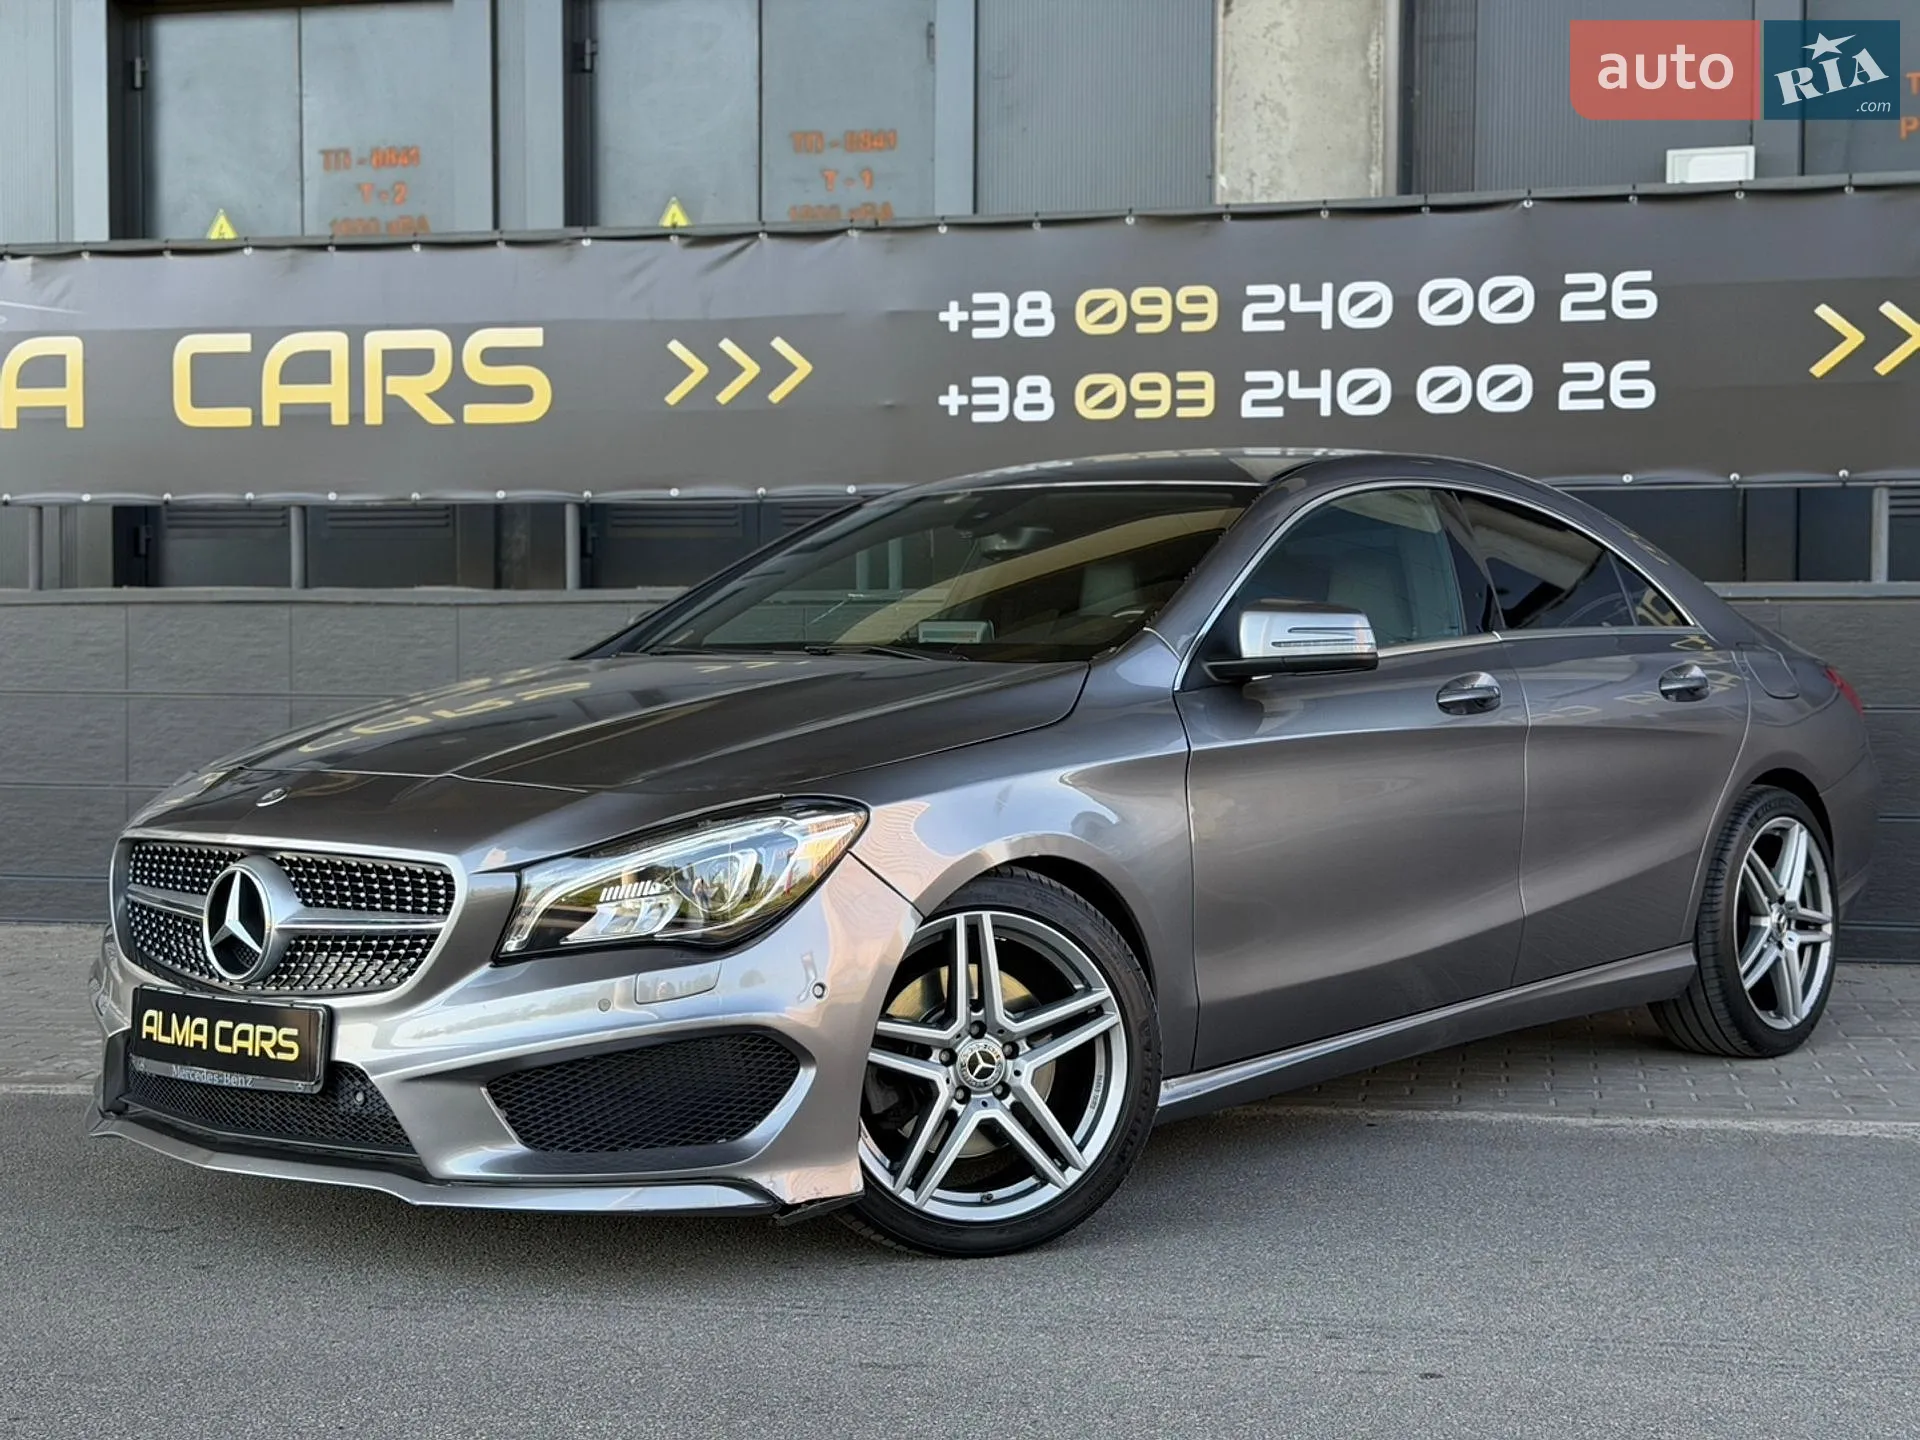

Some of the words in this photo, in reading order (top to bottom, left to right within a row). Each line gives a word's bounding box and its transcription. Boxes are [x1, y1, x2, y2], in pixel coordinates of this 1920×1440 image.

[939, 291, 1055, 338] +38
[1075, 285, 1218, 335] 099
[1242, 281, 1393, 332] 240
[1418, 275, 1535, 326] 00
[1560, 270, 1658, 322] 26
[173, 327, 552, 427] CARS
[938, 375, 1055, 422] +38
[1075, 370, 1216, 420] 093
[1241, 368, 1392, 418] 240
[1416, 364, 1533, 414] 00
[1558, 360, 1656, 411] 26
[142, 1009, 208, 1050] ALMA
[214, 1020, 300, 1062] CARS
